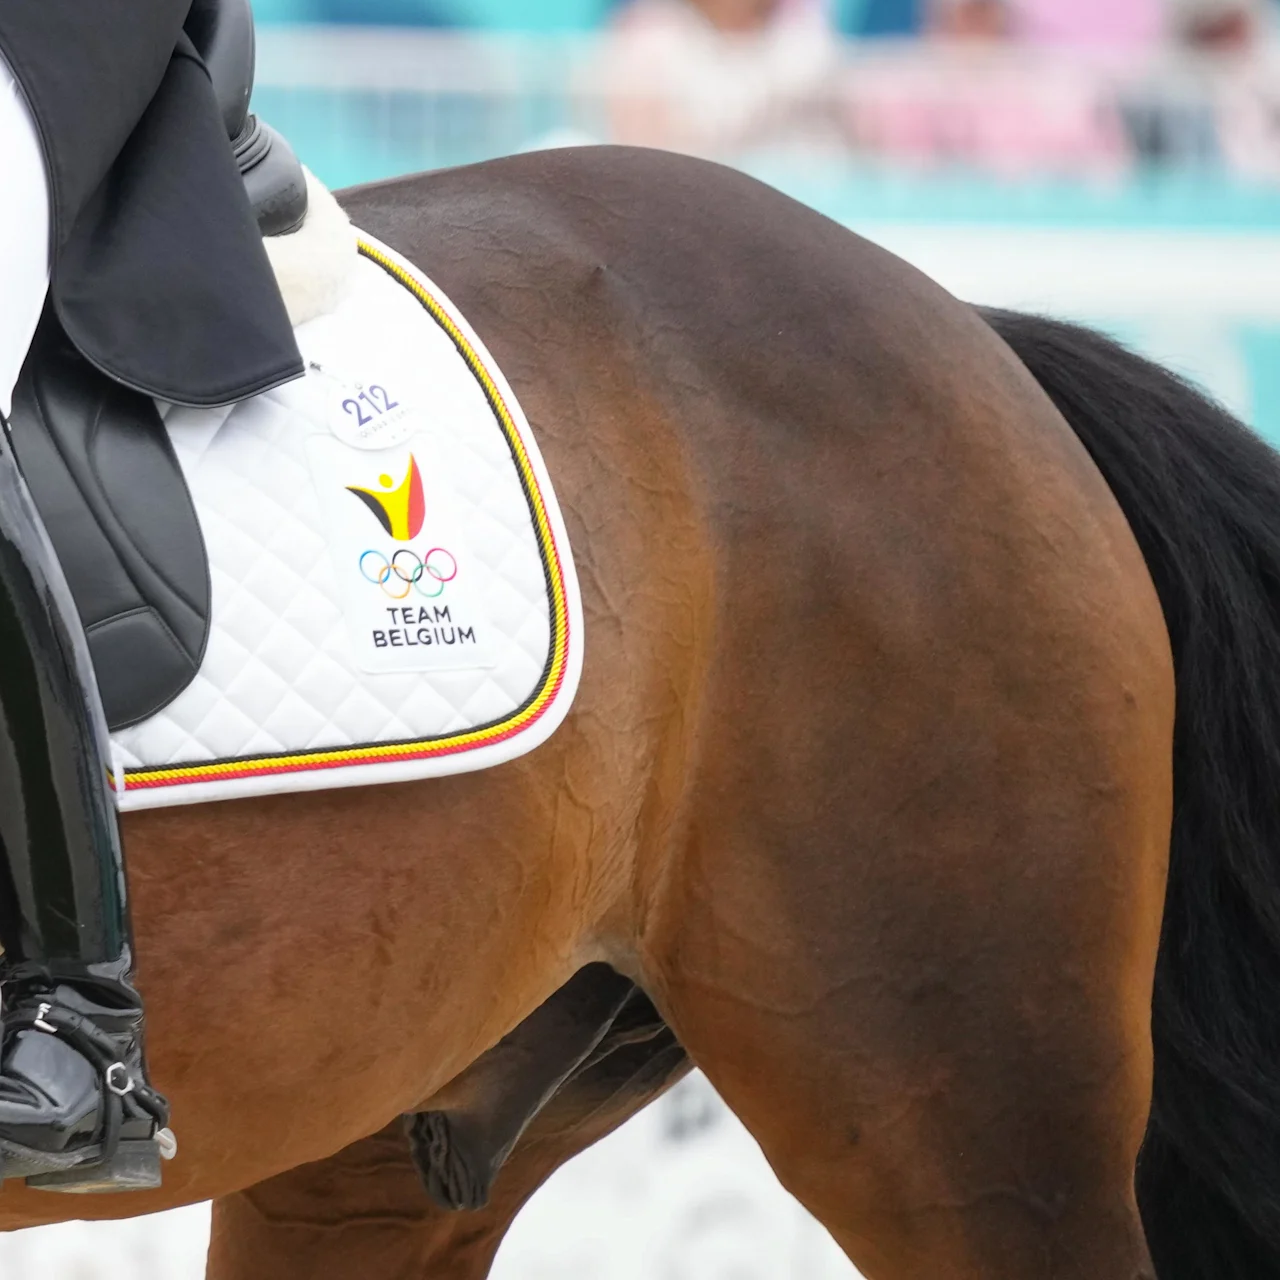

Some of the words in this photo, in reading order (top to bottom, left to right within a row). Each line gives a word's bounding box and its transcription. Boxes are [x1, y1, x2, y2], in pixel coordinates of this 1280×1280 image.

[341, 384, 400, 427] 212
[386, 604, 452, 625] TEAM
[372, 626, 477, 648] BELGIUM
